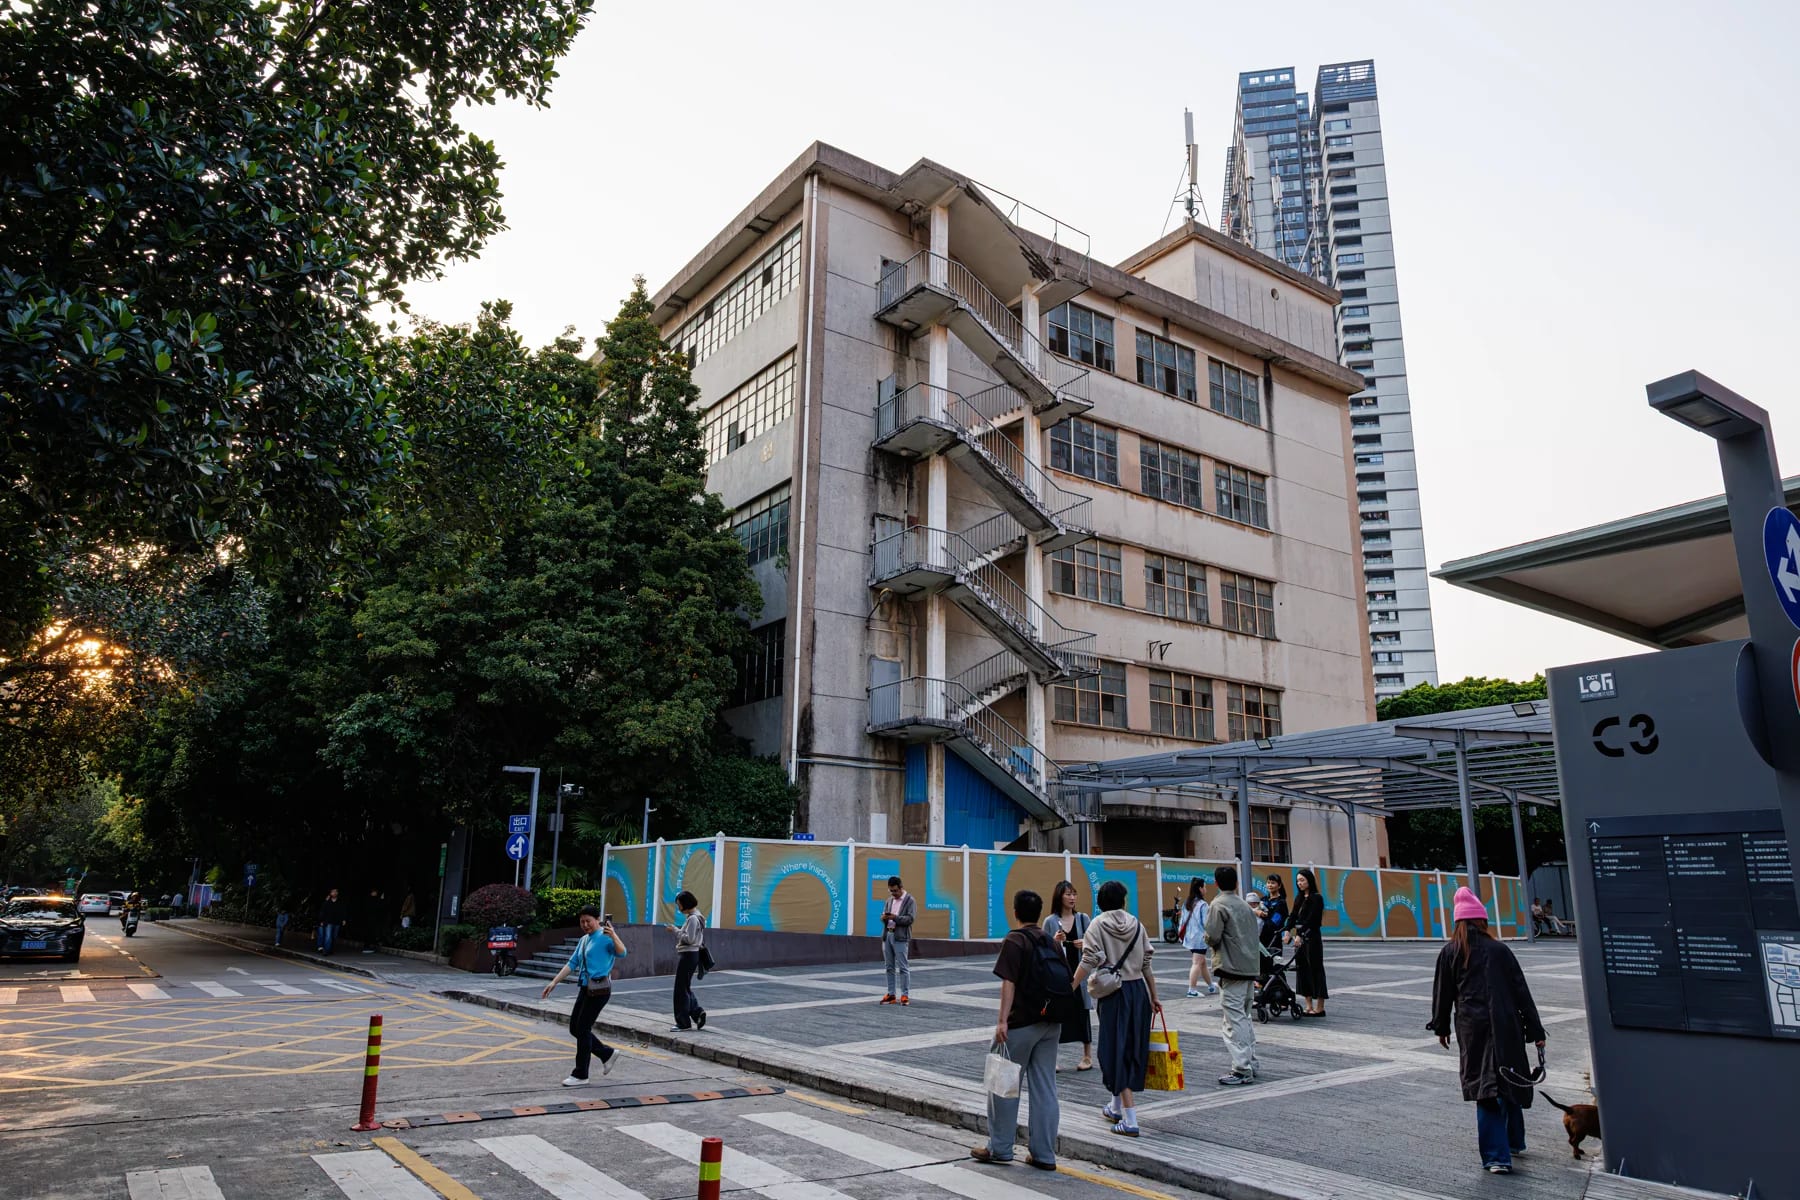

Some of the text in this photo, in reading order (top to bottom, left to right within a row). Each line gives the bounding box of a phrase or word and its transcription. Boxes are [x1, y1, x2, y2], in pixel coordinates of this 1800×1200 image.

[1592, 713, 1659, 758] C3
[513, 816, 527, 826] 出口
[739, 846, 753, 924] 创意自在生长
[781, 862, 808, 875] Where
[829, 900, 842, 931] Grows
